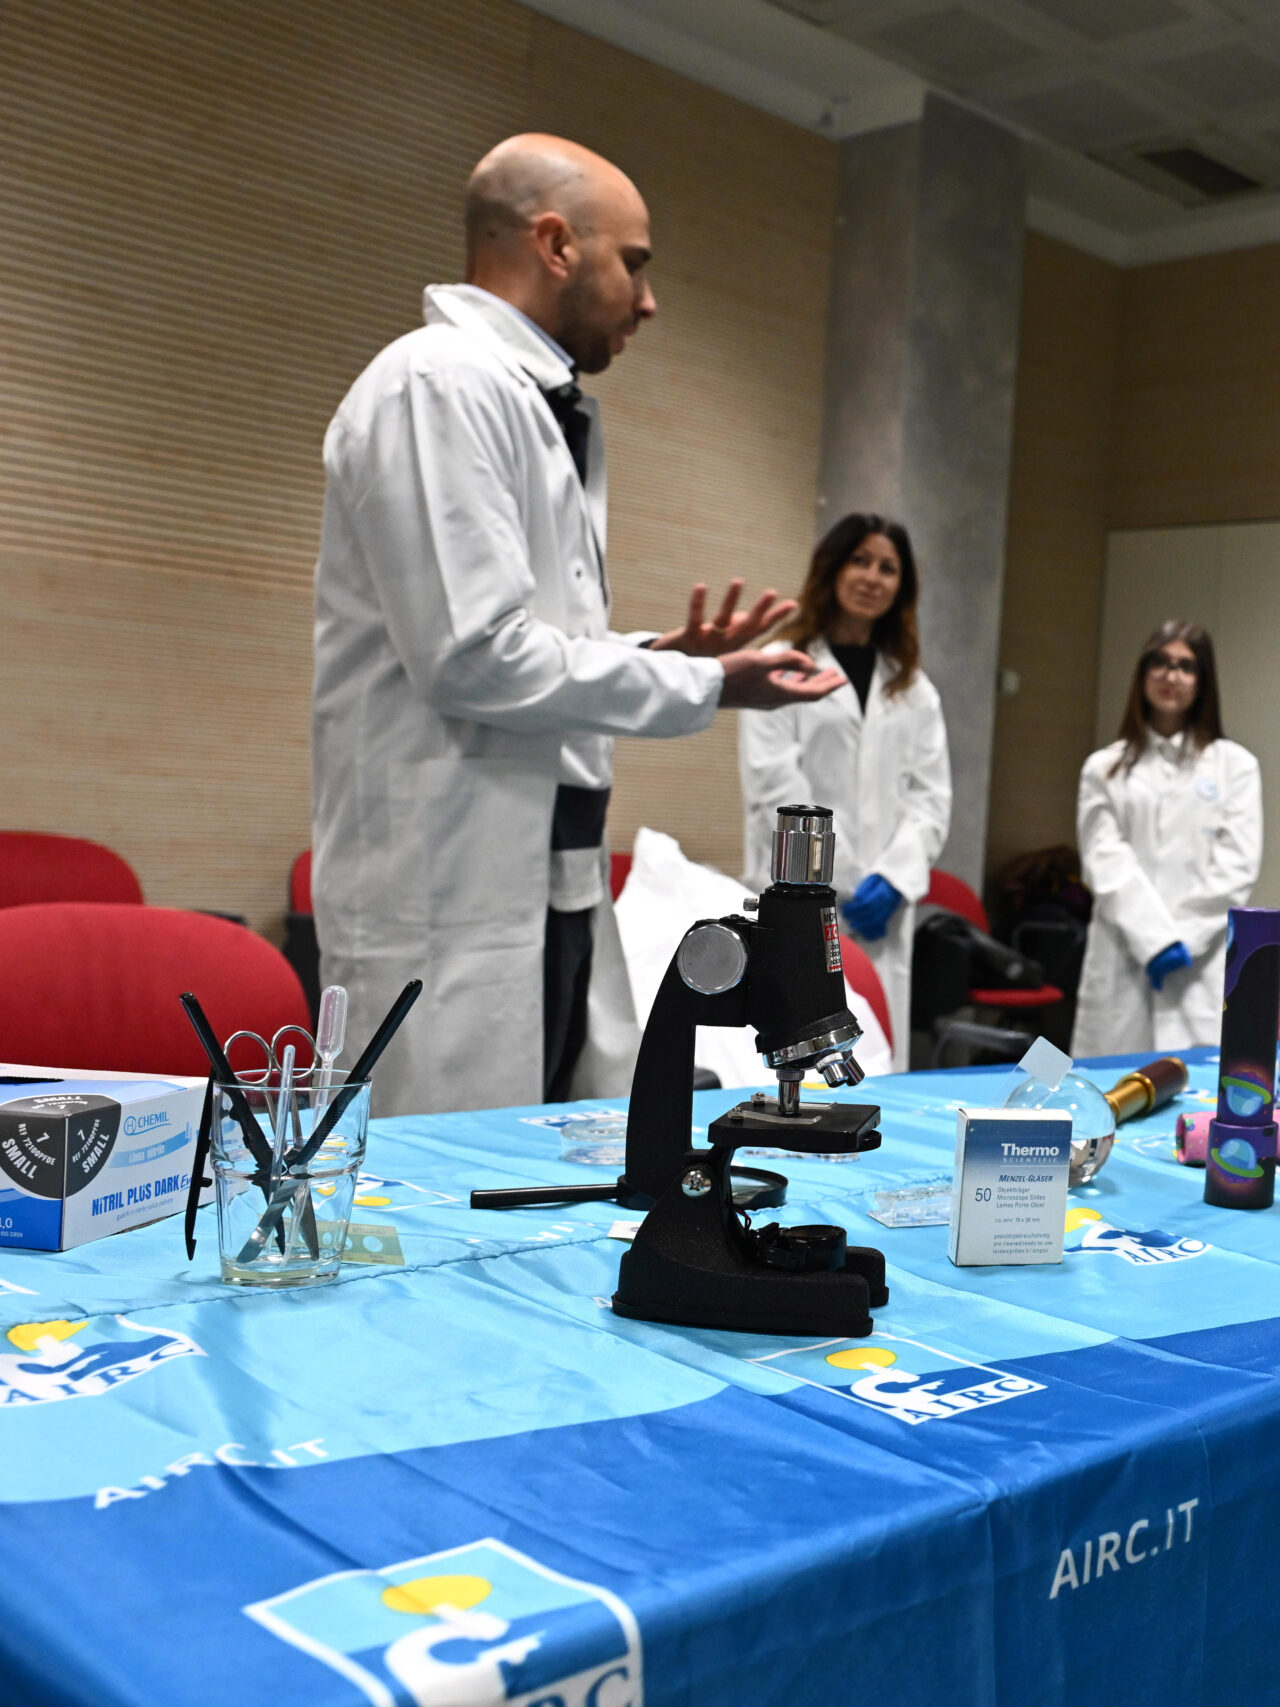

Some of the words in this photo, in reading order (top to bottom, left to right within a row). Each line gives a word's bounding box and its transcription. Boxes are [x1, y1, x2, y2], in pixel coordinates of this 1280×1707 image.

[18, 1123, 28, 1136] REF
[138, 1111, 169, 1129] CHEMIL
[36, 1131, 50, 1143] 7
[77, 1129, 86, 1141] 7
[2, 1138, 37, 1179] SMALL
[82, 1133, 110, 1174] SMALL
[1001, 1143, 1060, 1156] Thermo
[127, 1183, 152, 1206] PLUS
[154, 1174, 180, 1197] DARK
[975, 1187, 992, 1202] 50
[1123, 1238, 1207, 1263] AIRC
[6, 1342, 195, 1403] AIRC
[903, 1379, 1035, 1420] AIRC
[94, 1438, 329, 1509] AIRC.IT
[1049, 1498, 1199, 1600] AIRC.IT
